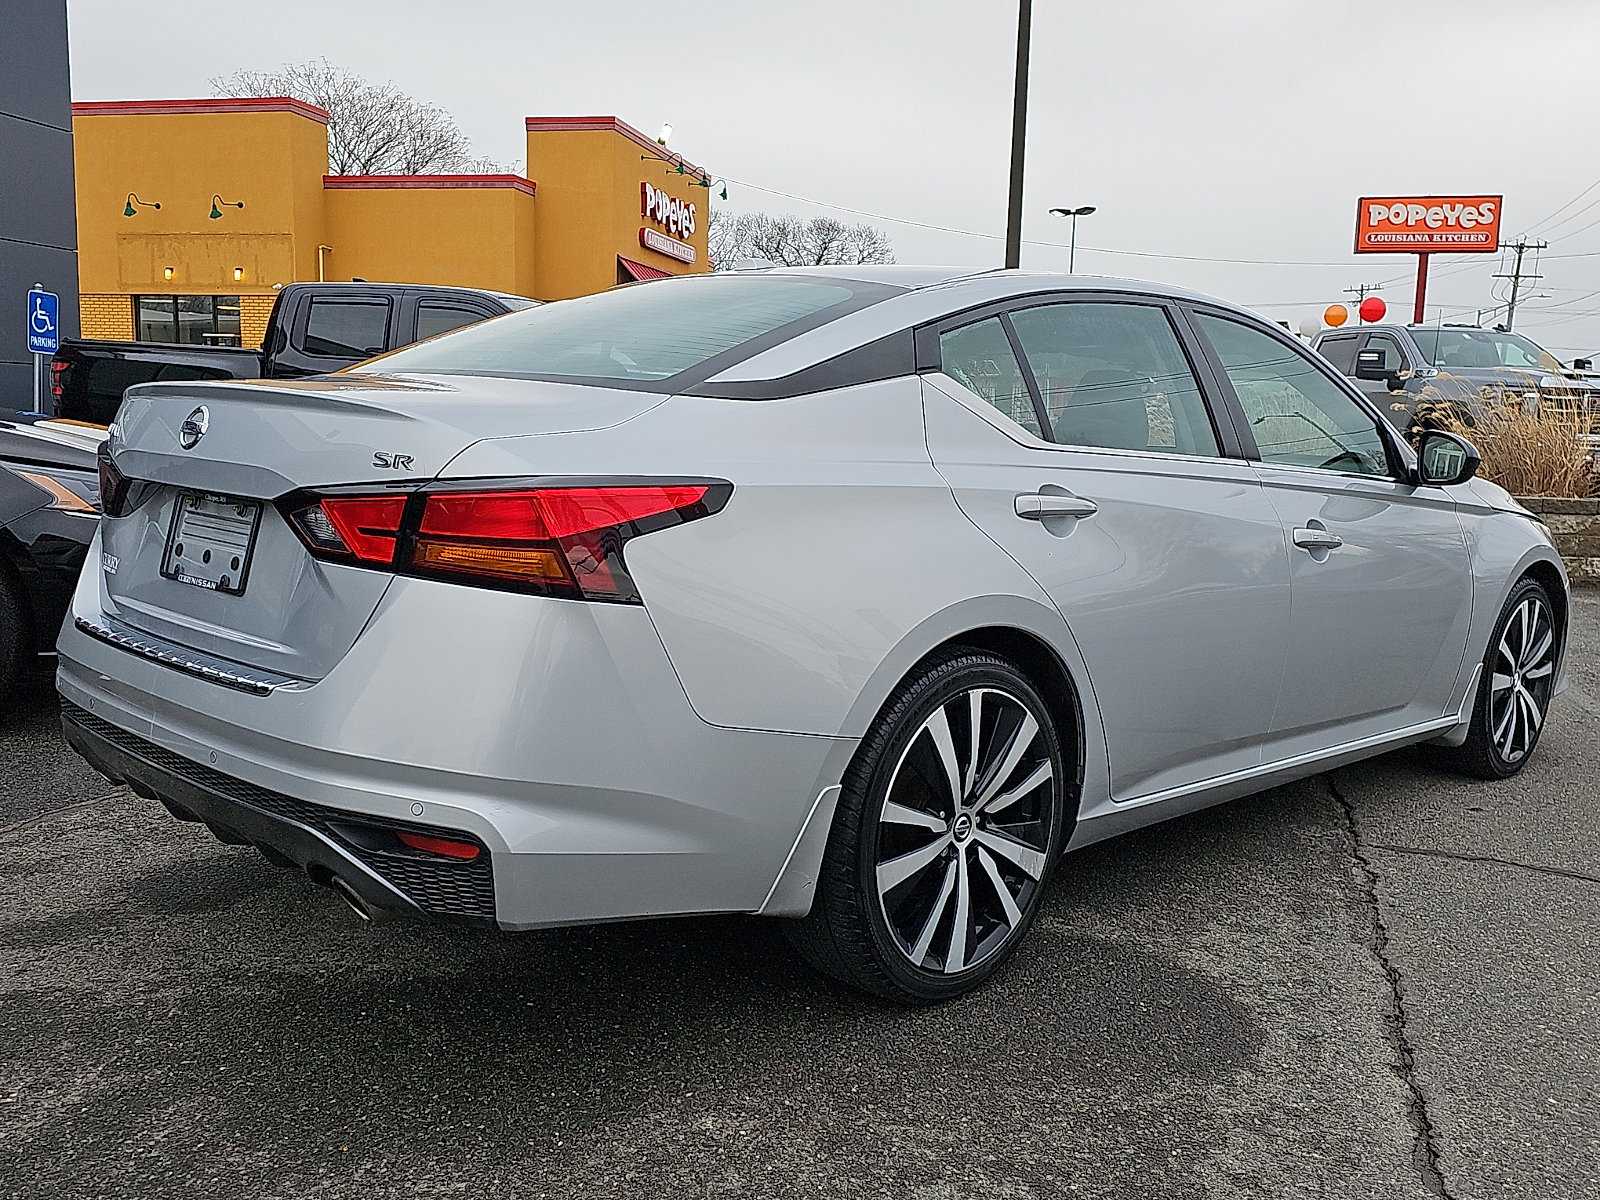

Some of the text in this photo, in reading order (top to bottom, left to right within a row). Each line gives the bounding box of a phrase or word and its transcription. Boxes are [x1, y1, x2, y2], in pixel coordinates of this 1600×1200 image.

[1370, 233, 1487, 242] LOUISIANA KITCHEN
[30, 335, 56, 348] PARKING
[372, 451, 415, 471] SR
